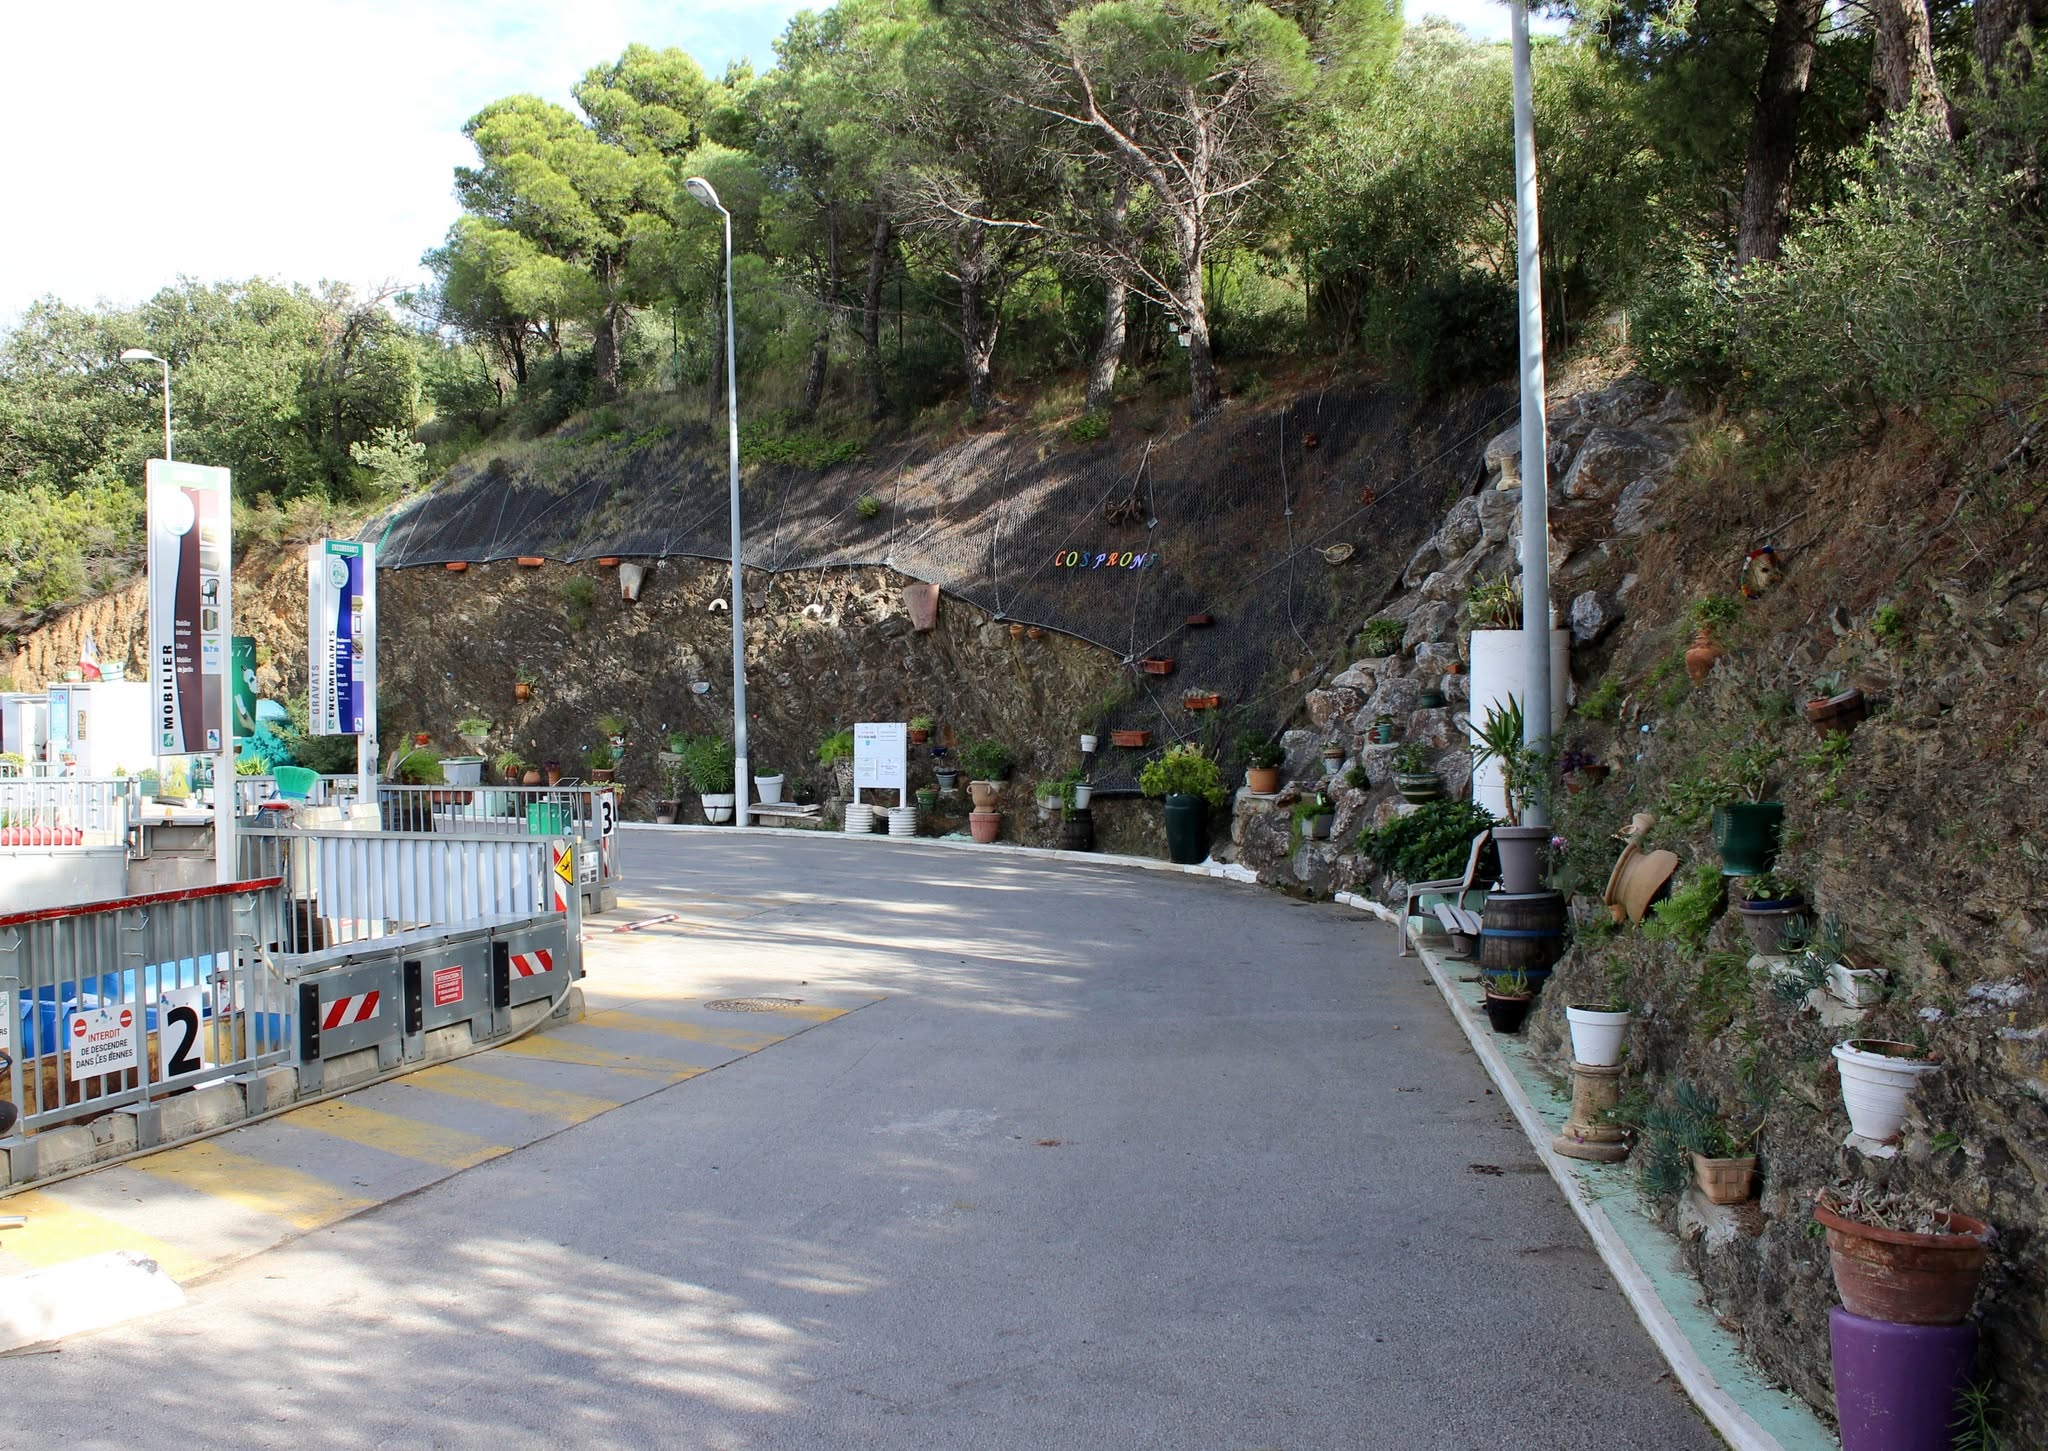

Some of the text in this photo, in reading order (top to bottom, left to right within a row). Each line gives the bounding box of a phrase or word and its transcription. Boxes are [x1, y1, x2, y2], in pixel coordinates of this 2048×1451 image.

[162, 645, 174, 730] MOBILIER
[311, 665, 320, 715] GRAVATS
[602, 802, 612, 834] 3
[81, 1039, 128, 1056] DE DESCENDRE
[88, 1028, 120, 1042] INTERDIT
[167, 1006, 201, 1077] 2
[76, 1049, 133, 1069] DANS LES BENNES
